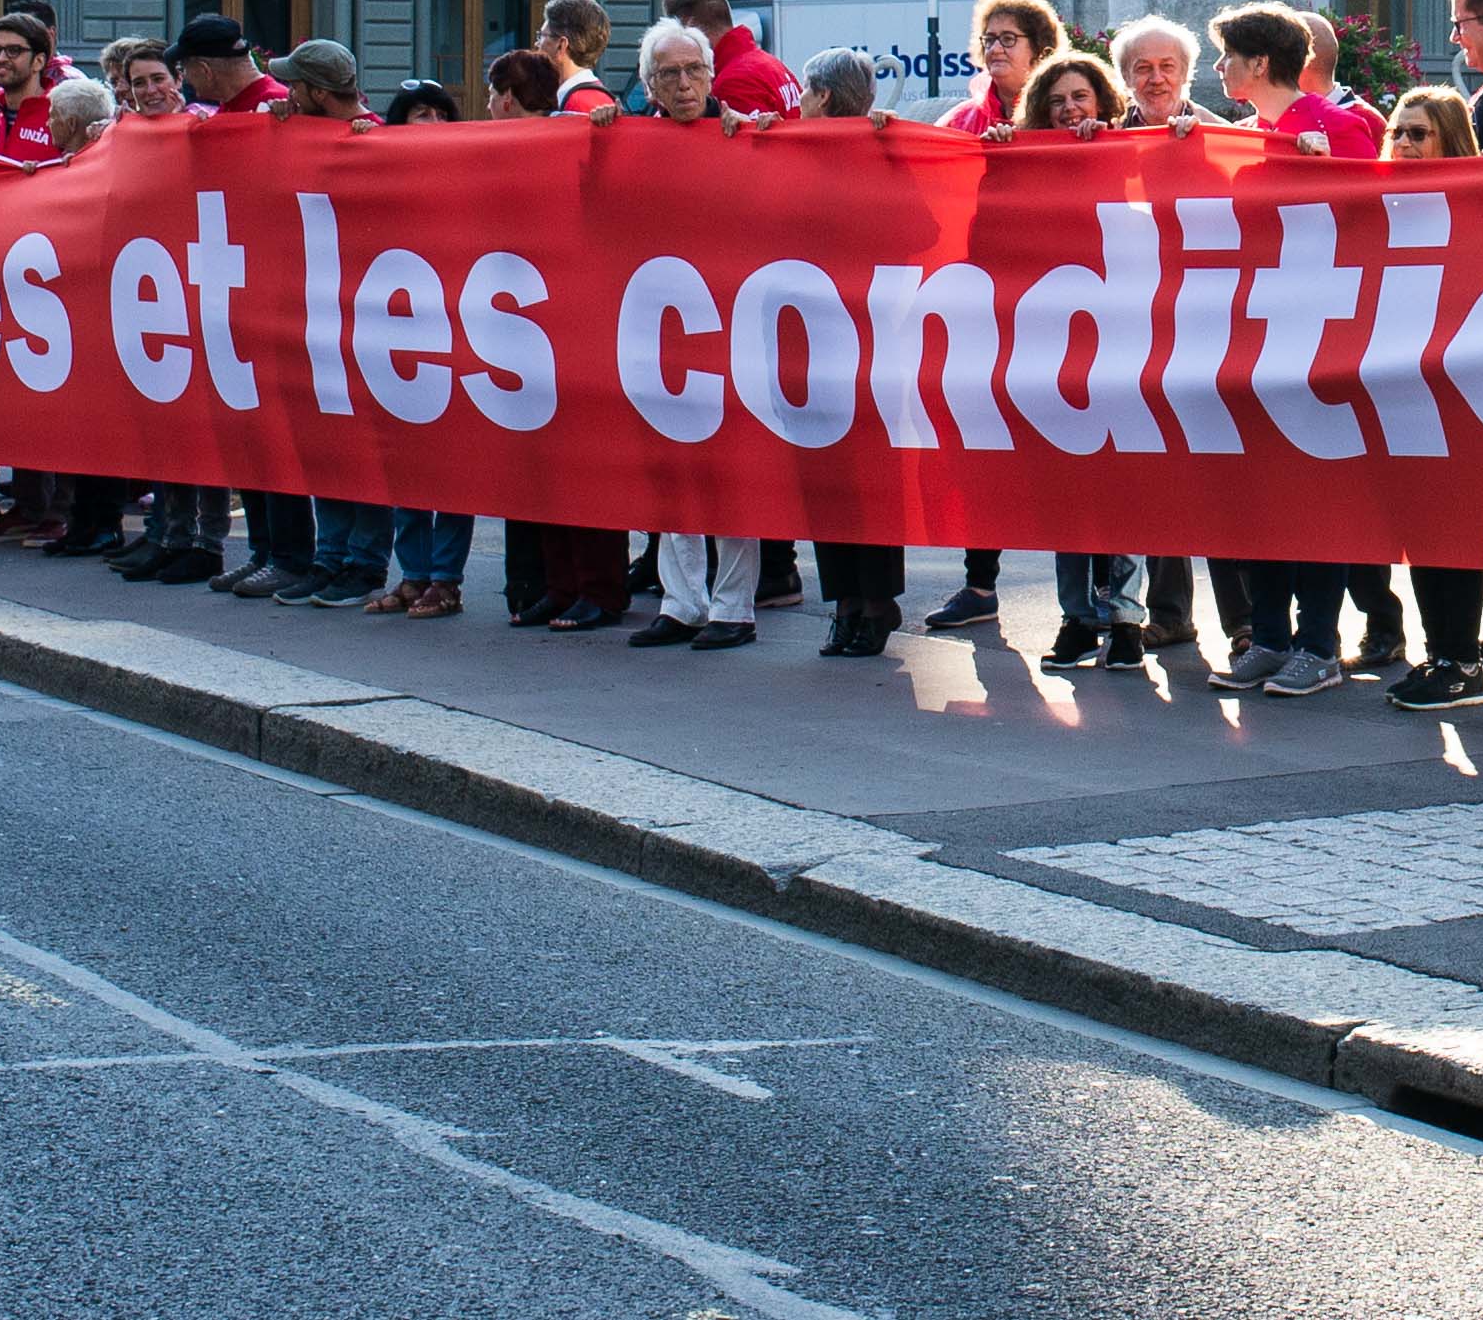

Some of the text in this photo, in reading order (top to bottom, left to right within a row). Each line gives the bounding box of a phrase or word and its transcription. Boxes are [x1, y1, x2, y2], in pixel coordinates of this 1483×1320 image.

[19, 126, 49, 145] UNIA
[110, 190, 260, 411] et
[296, 192, 558, 432] les
